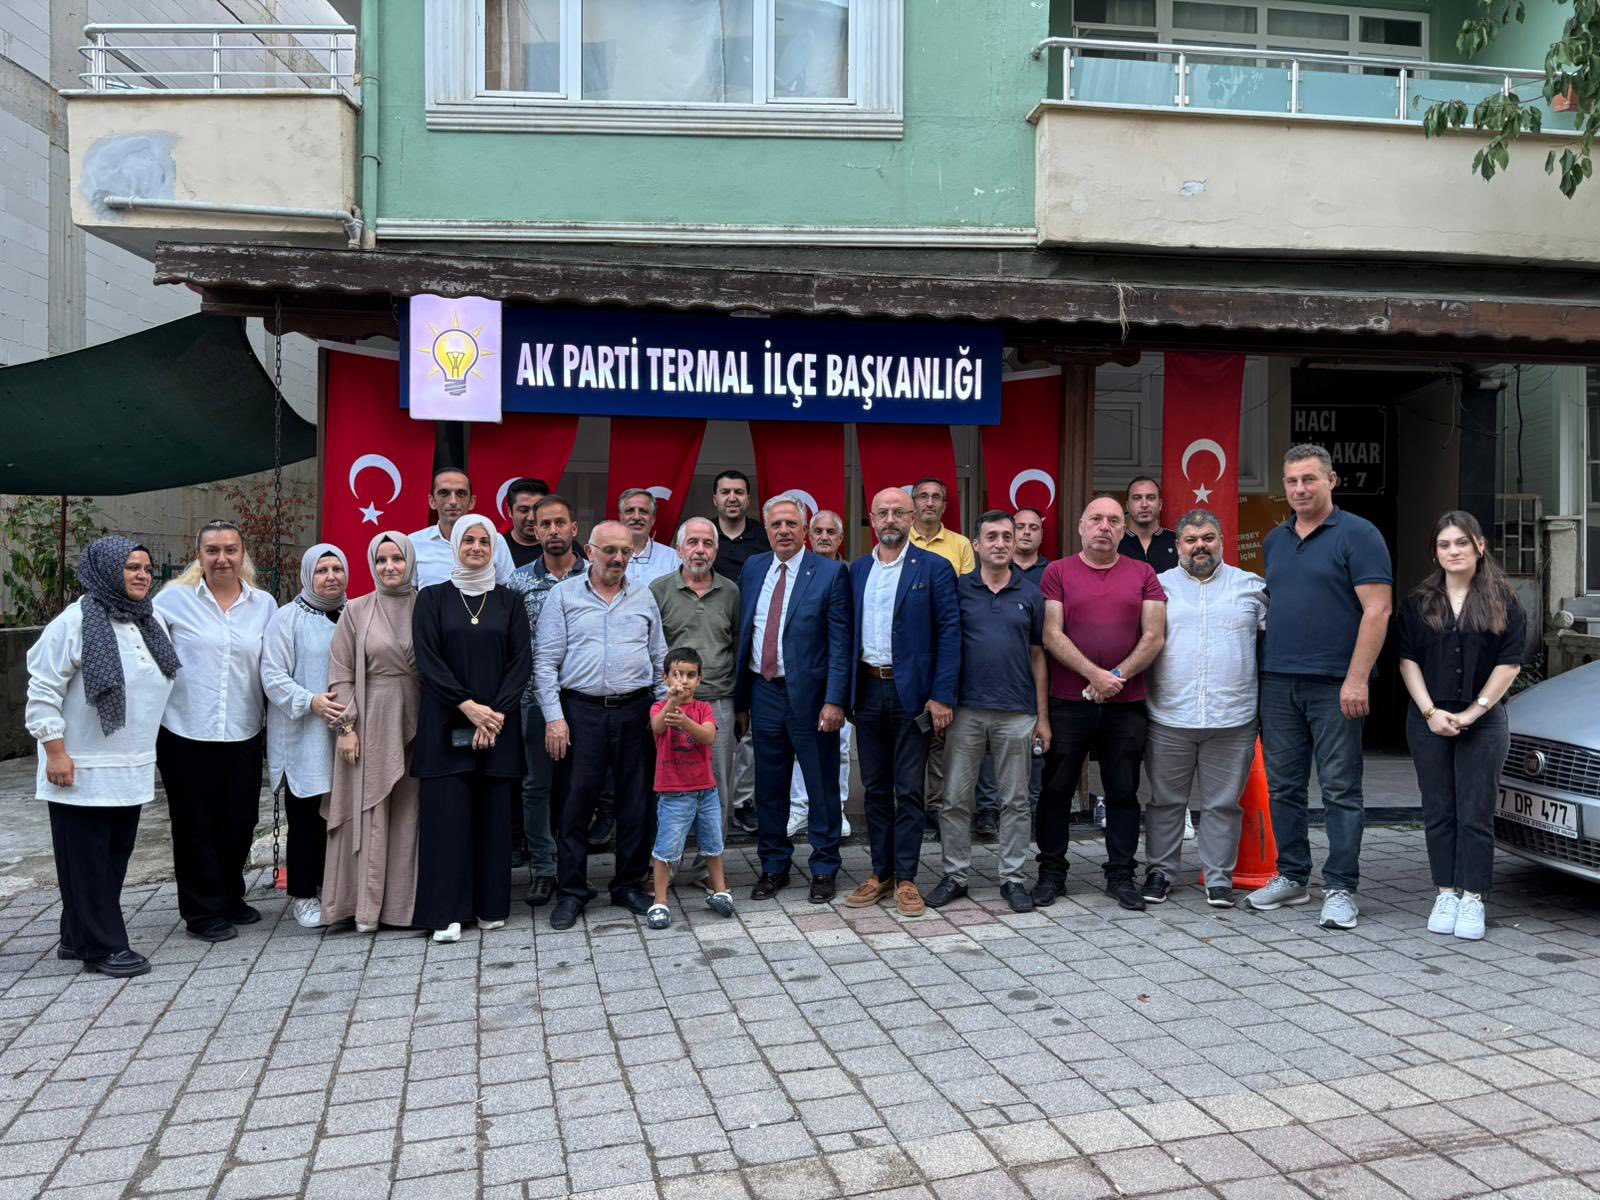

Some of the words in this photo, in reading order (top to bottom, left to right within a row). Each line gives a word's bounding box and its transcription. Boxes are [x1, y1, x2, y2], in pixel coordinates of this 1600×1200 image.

[515, 342, 555, 387] AK
[563, 336, 640, 391] PARTİ
[646, 347, 754, 395] TERMAL
[764, 339, 817, 409] İLÇE
[826, 345, 982, 411] BAŞKANLIĞI
[1294, 410, 1337, 432] HACI
[1331, 442, 1381, 464] AKAR
[1356, 471, 1368, 488] 7
[1514, 793, 1533, 817] DR
[1541, 799, 1568, 825] 477
